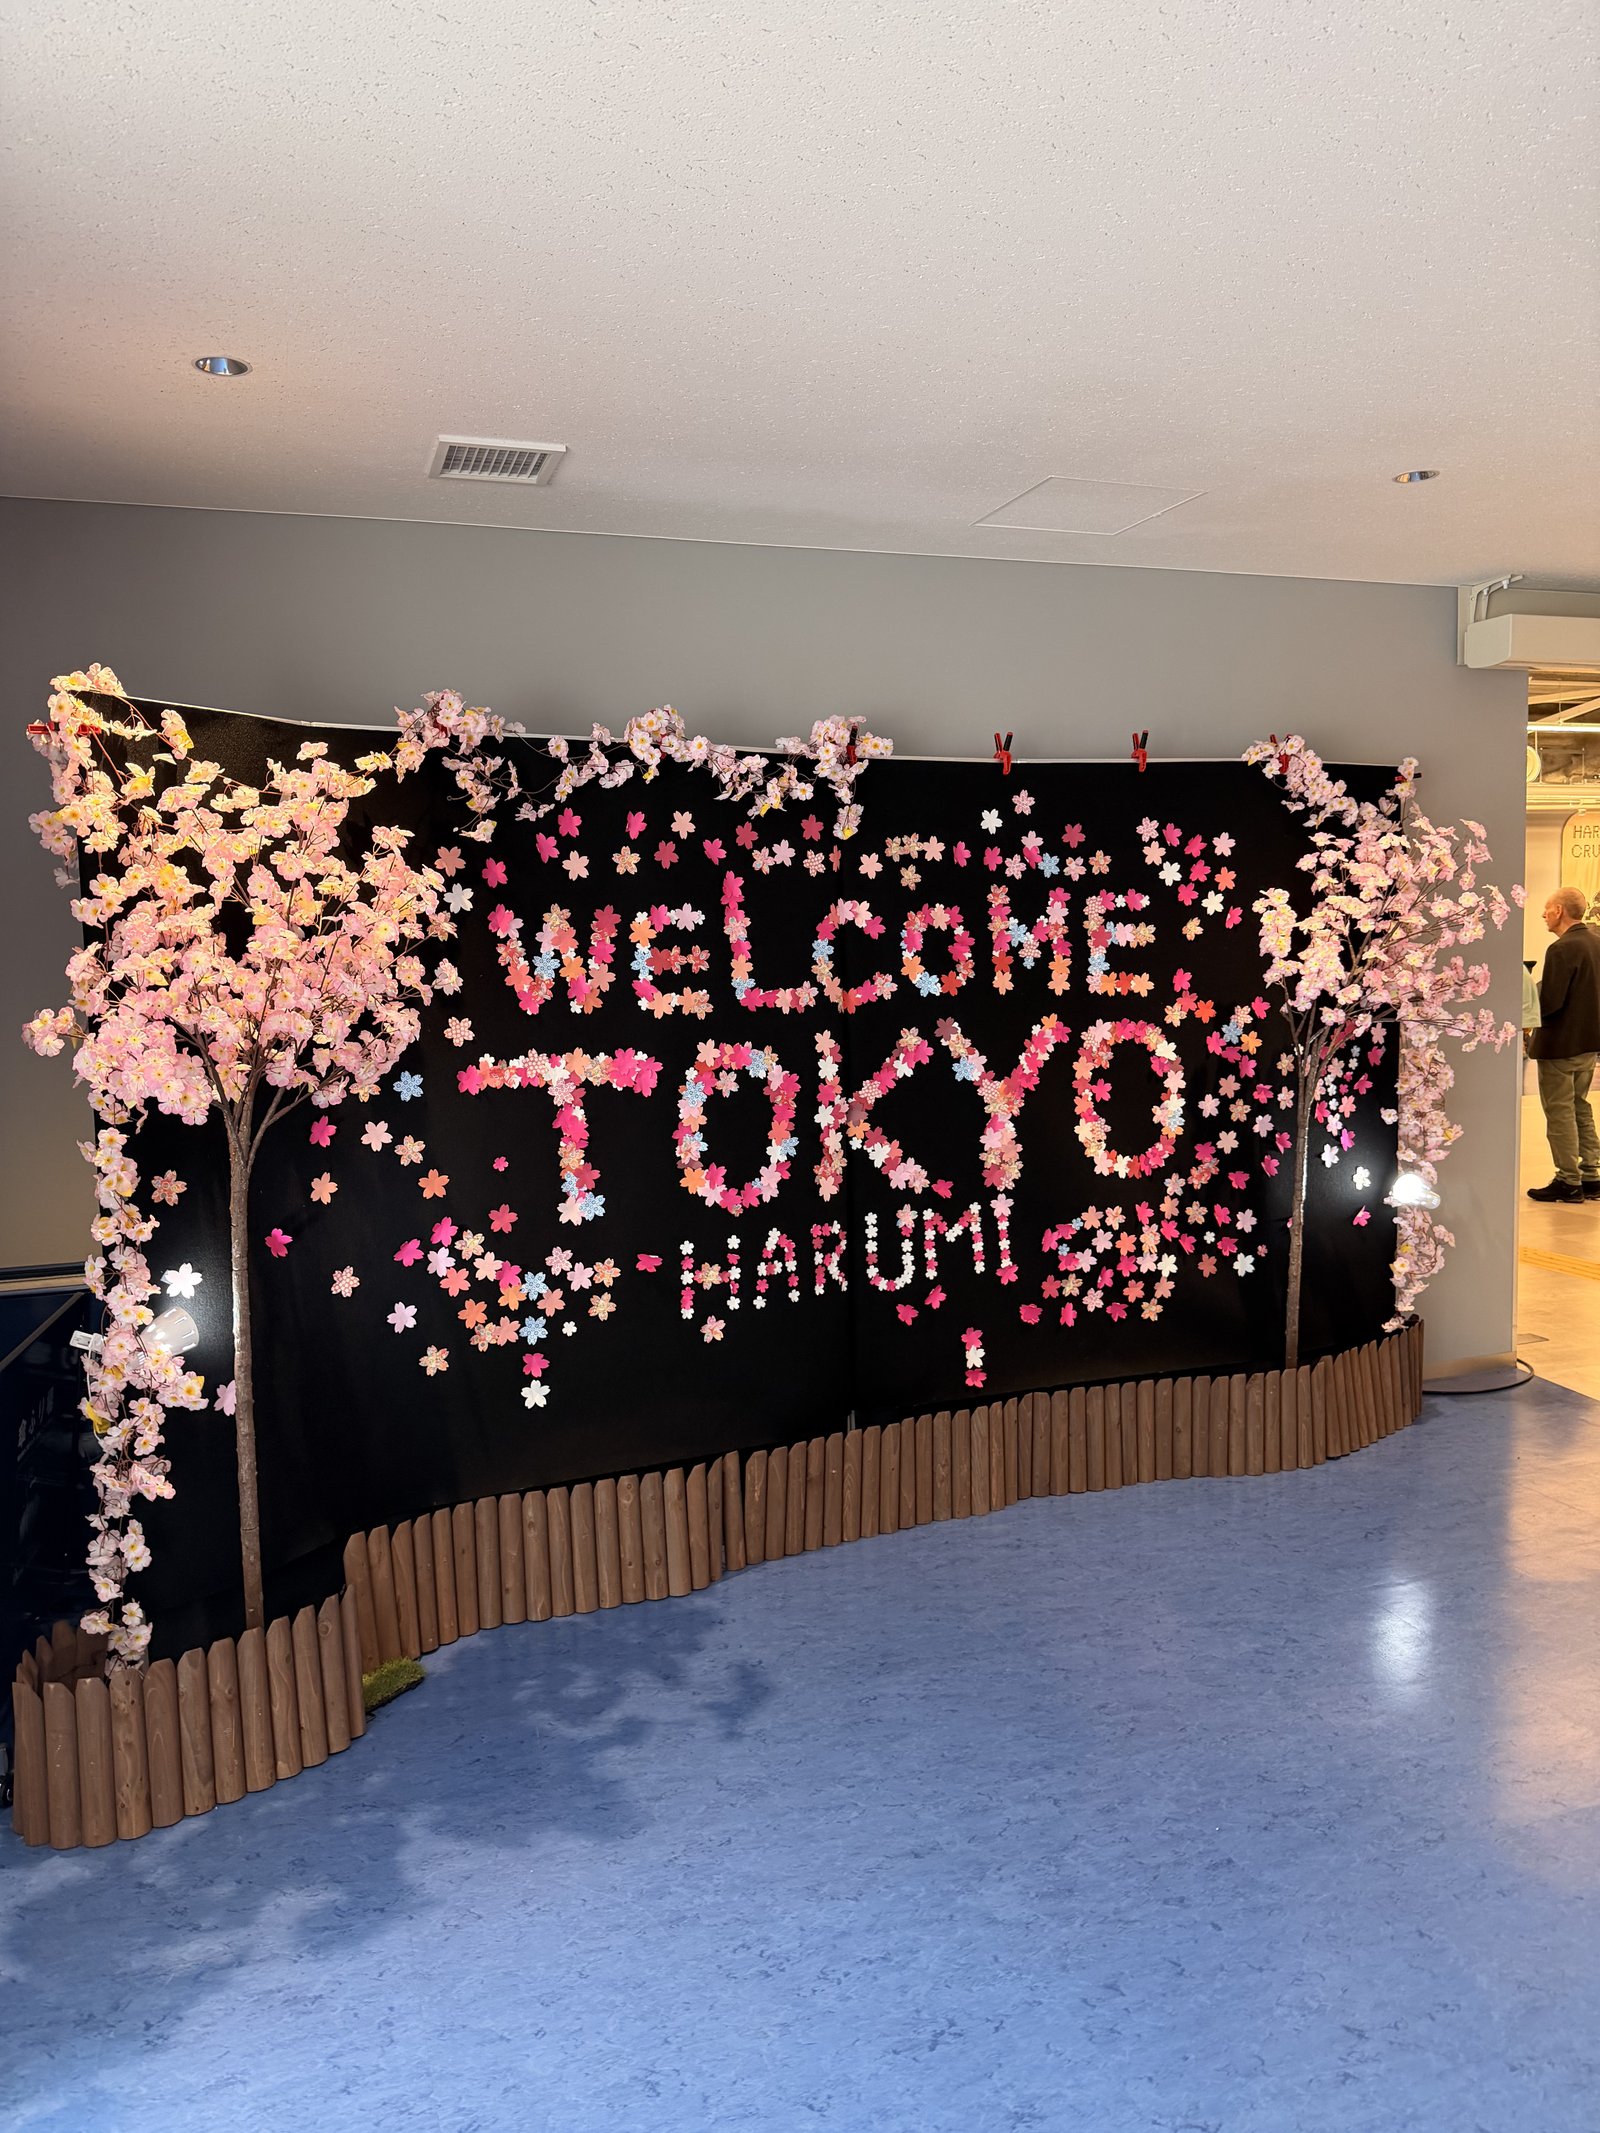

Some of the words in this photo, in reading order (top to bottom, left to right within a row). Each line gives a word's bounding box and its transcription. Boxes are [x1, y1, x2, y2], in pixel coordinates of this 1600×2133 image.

[487, 870, 1157, 1018] WELCOME
[456, 1013, 1186, 1225] TOKYO
[680, 1193, 1019, 1320] HARUMI
